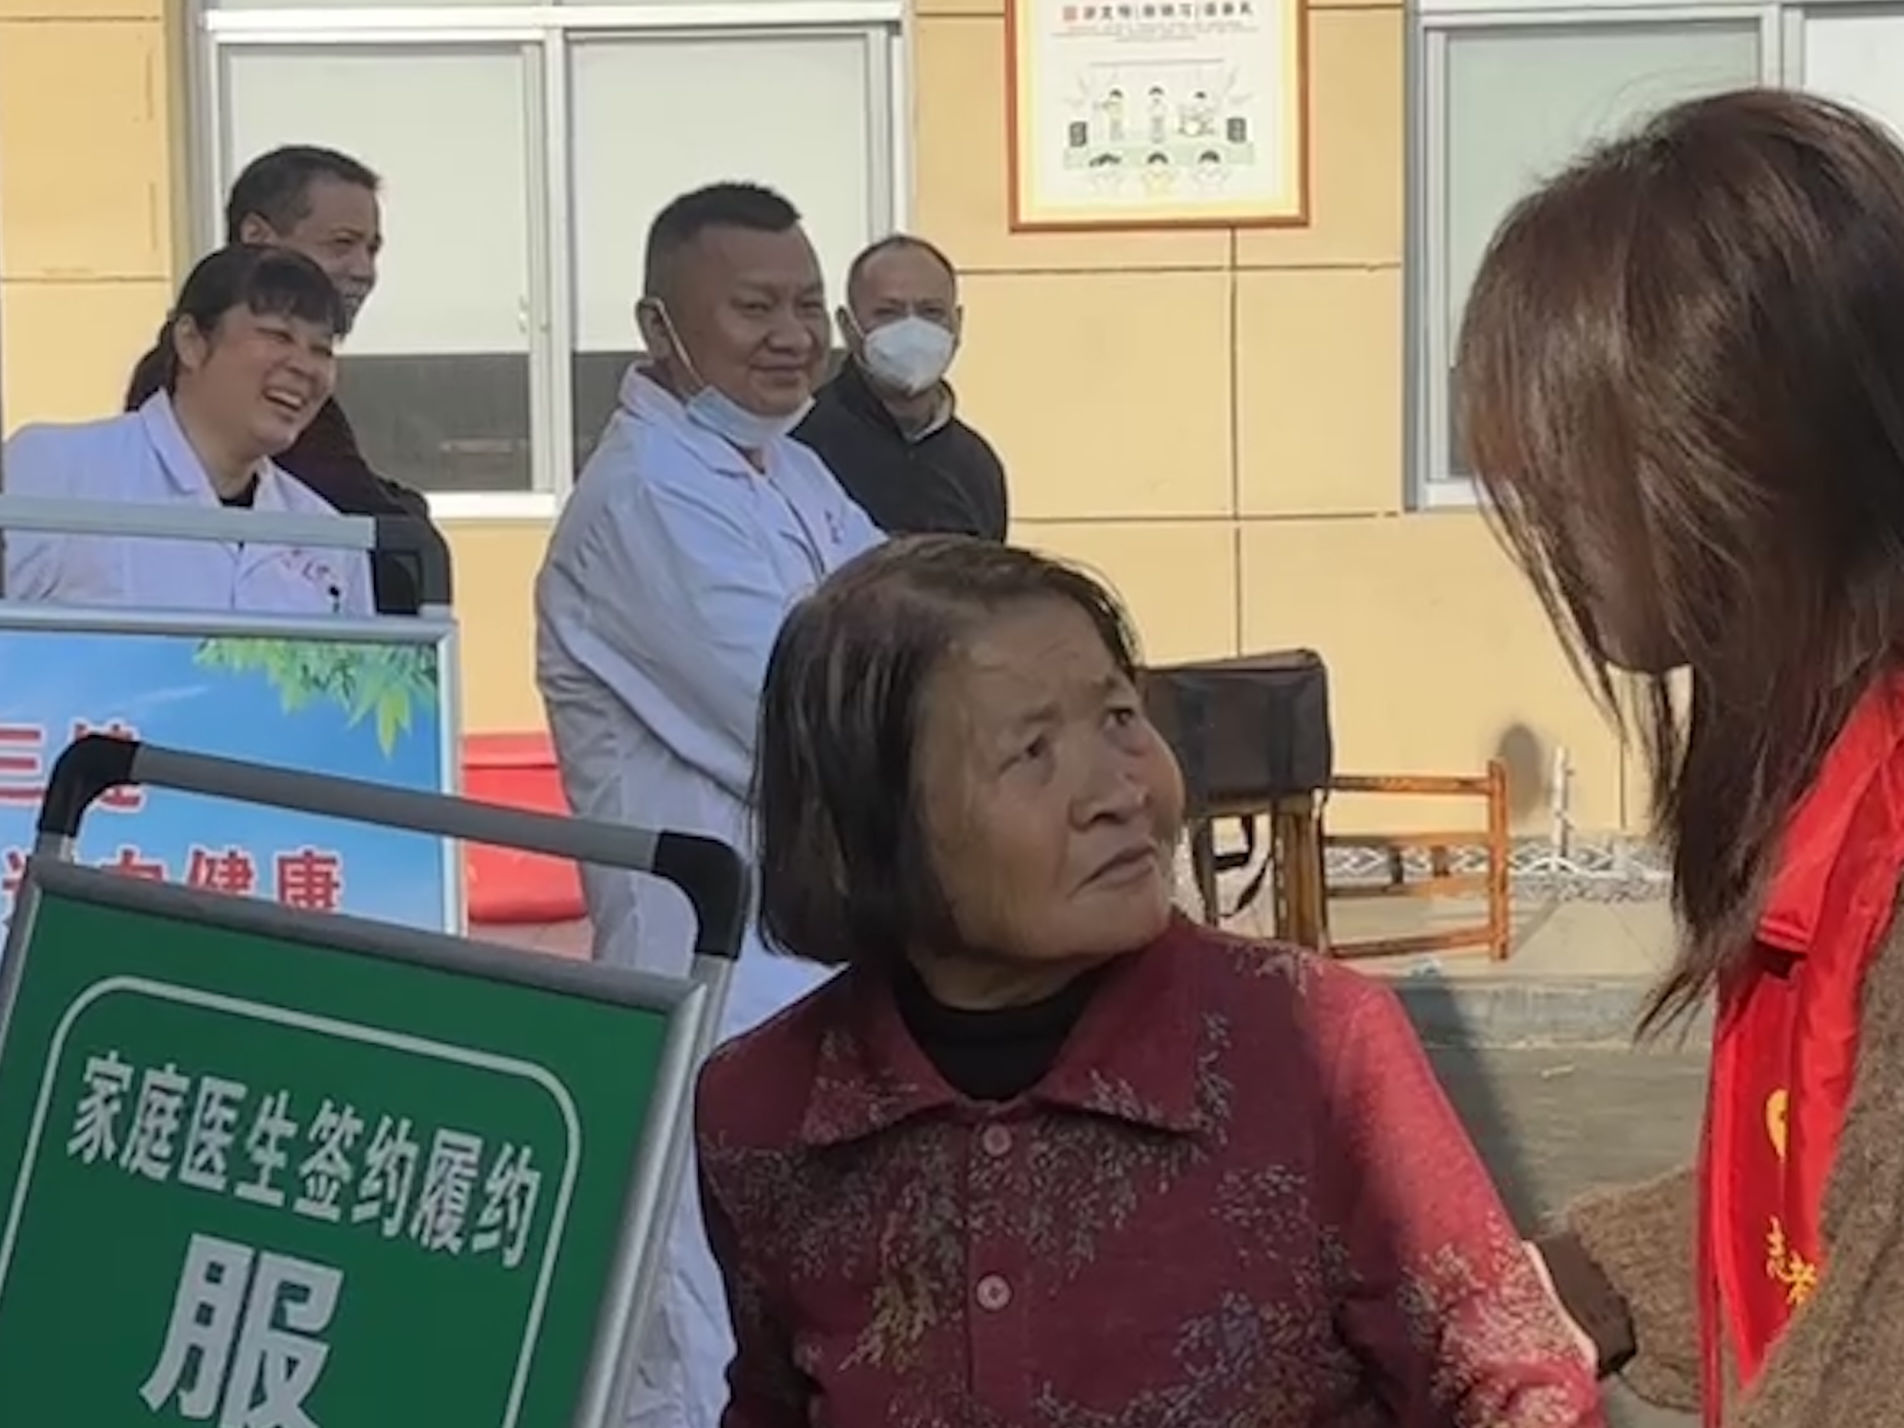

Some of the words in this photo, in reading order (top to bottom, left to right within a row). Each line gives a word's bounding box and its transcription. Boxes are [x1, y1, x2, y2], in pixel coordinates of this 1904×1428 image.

[64, 1049, 544, 1271] 家庭医生签约履约
